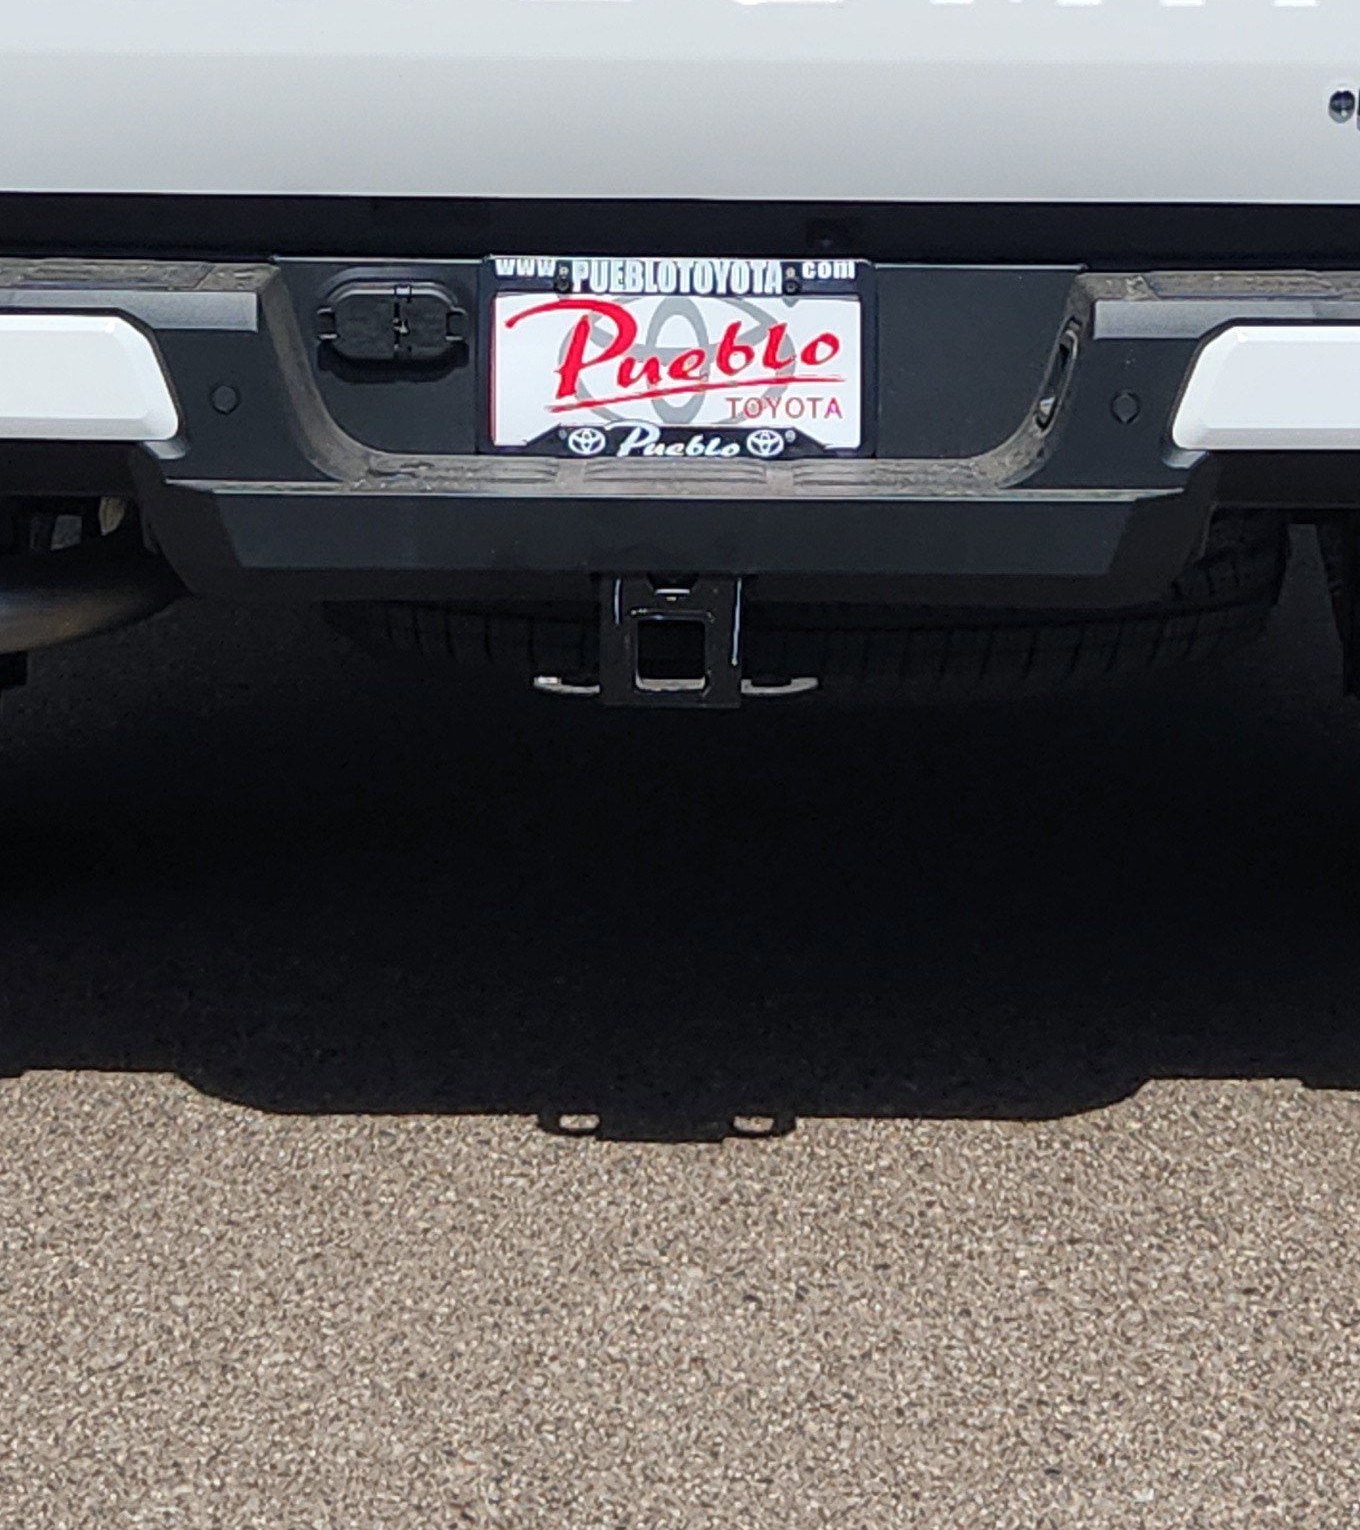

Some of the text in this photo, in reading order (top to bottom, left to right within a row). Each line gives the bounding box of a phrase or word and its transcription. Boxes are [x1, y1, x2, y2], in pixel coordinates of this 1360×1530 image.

[571, 260, 783, 294] PUEBLOTOYOTA
[505, 298, 841, 400] Pueblo
[726, 396, 844, 420] TOYOTA
[604, 421, 741, 458] Pueblo
